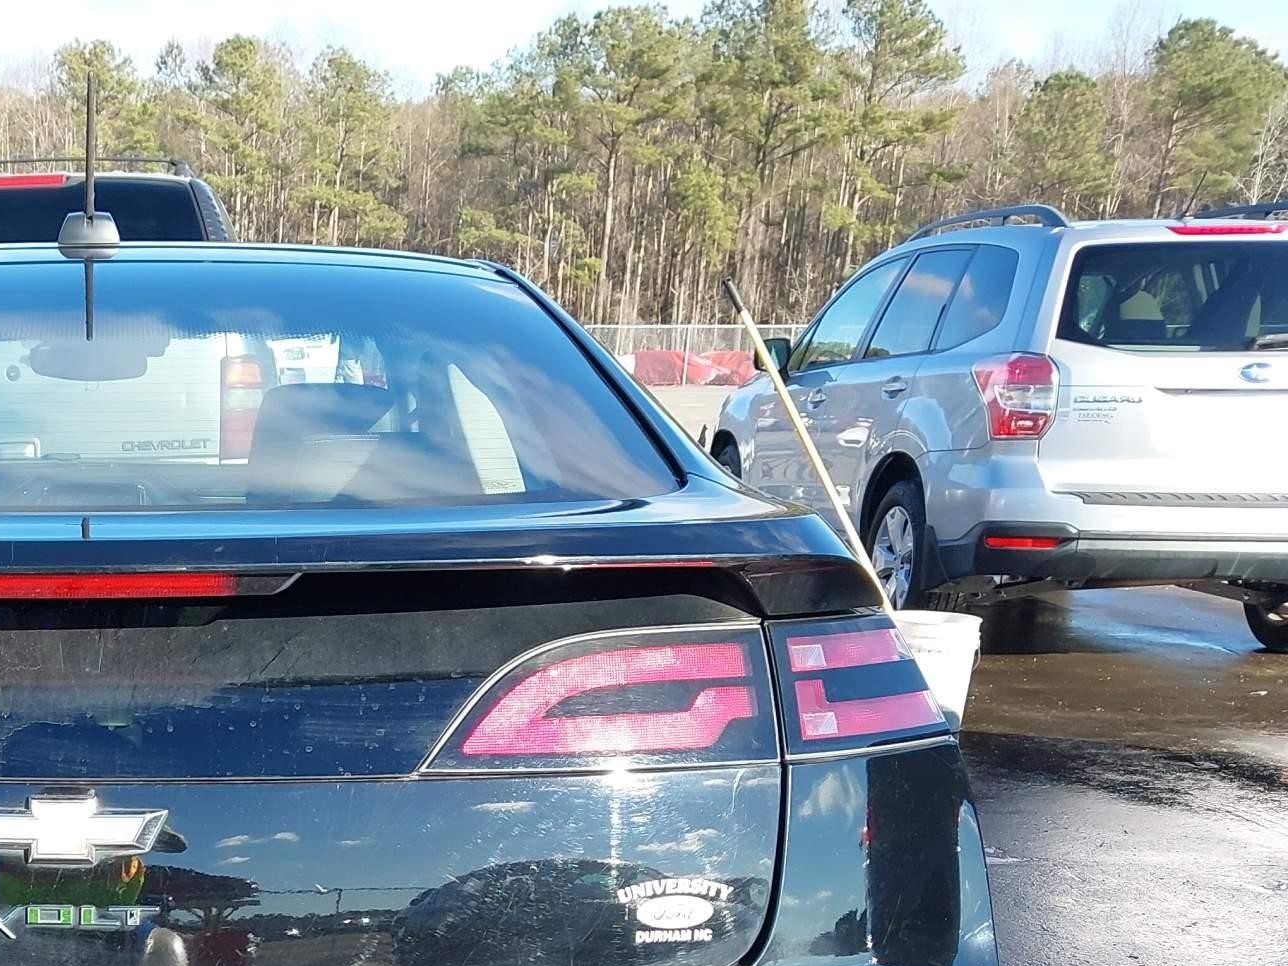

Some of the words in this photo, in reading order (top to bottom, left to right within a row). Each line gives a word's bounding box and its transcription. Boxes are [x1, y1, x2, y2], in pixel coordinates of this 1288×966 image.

[121, 438, 211, 452] CHEVROLET
[617, 878, 735, 903] UNIVERSITY
[635, 929, 692, 943] DURHAM
[694, 928, 713, 942] NC
